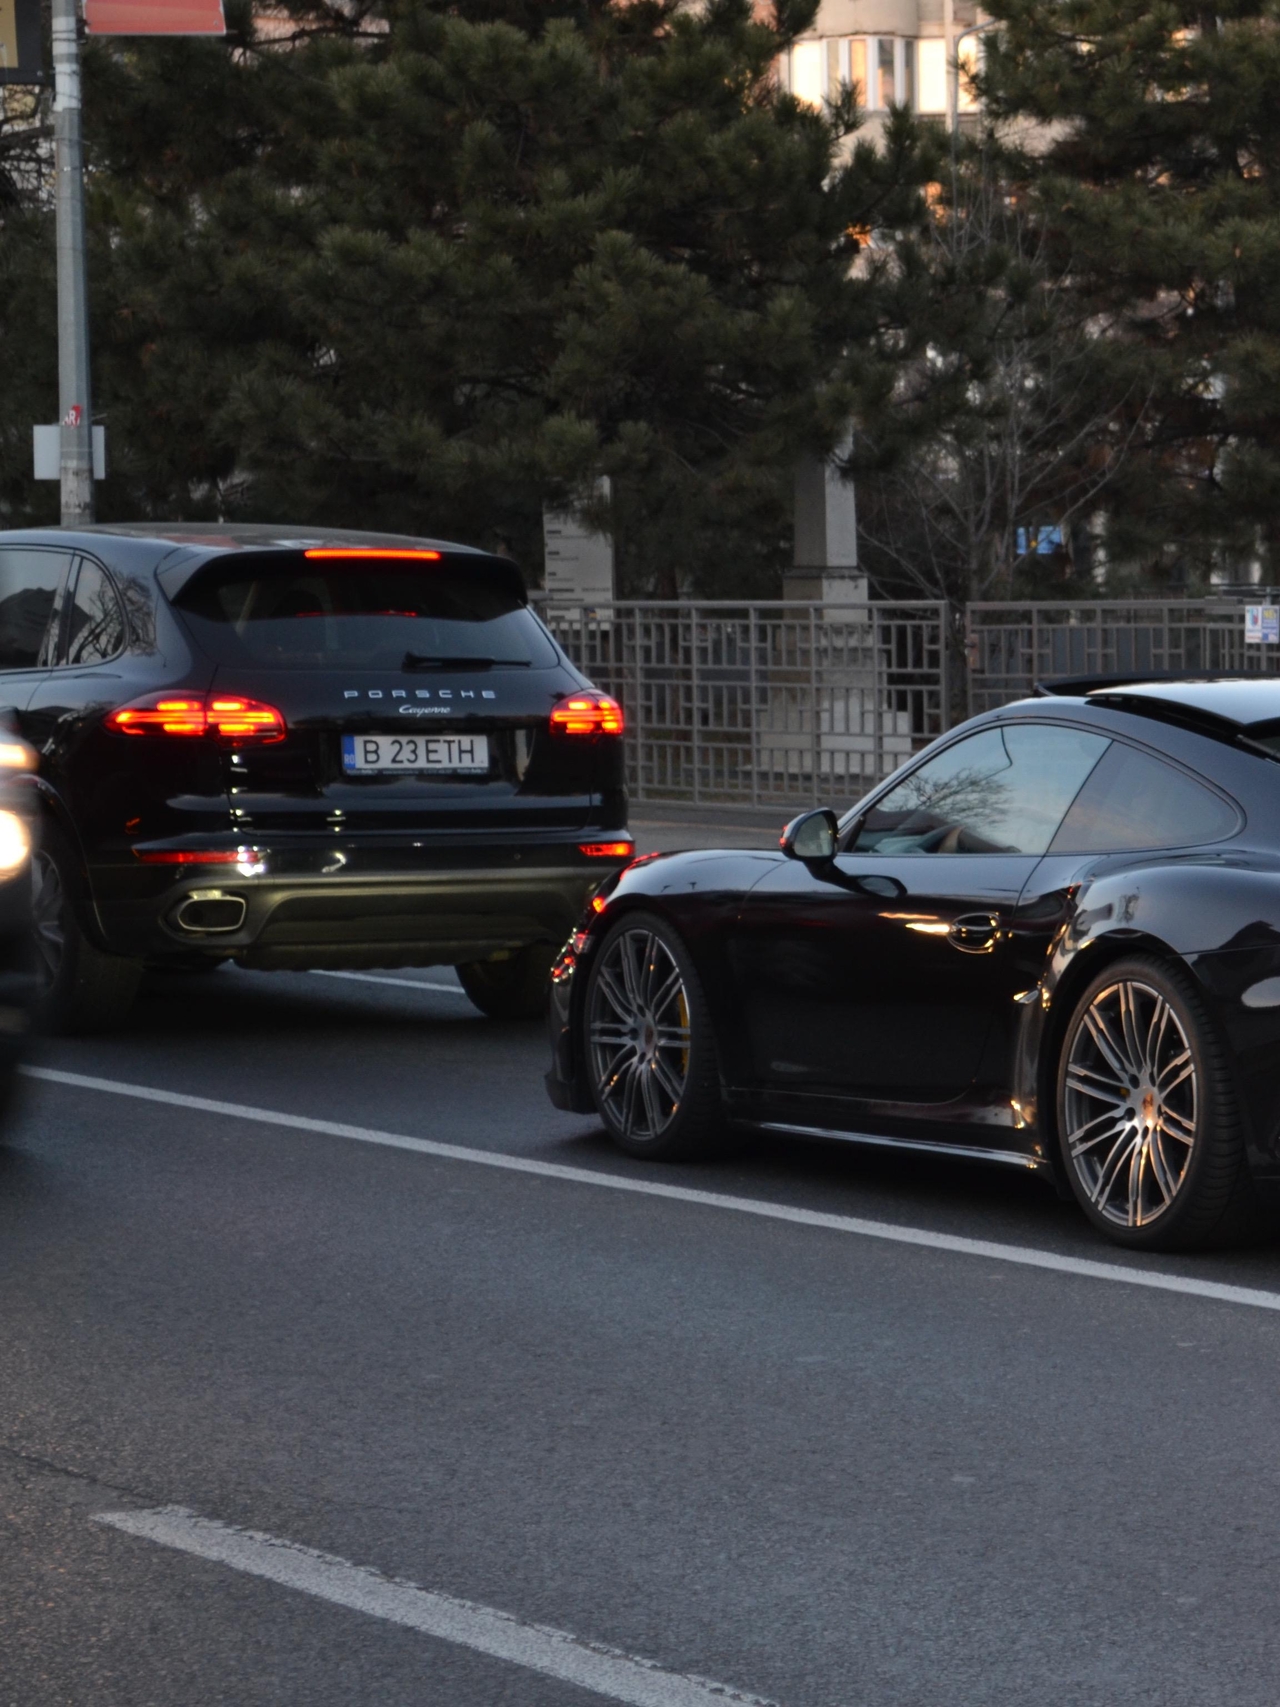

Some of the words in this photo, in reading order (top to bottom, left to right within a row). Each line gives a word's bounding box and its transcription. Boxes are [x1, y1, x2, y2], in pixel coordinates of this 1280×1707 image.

[343, 690, 496, 699] PORSCHE
[399, 704, 451, 717] Cayenne
[344, 754, 355, 765] RO
